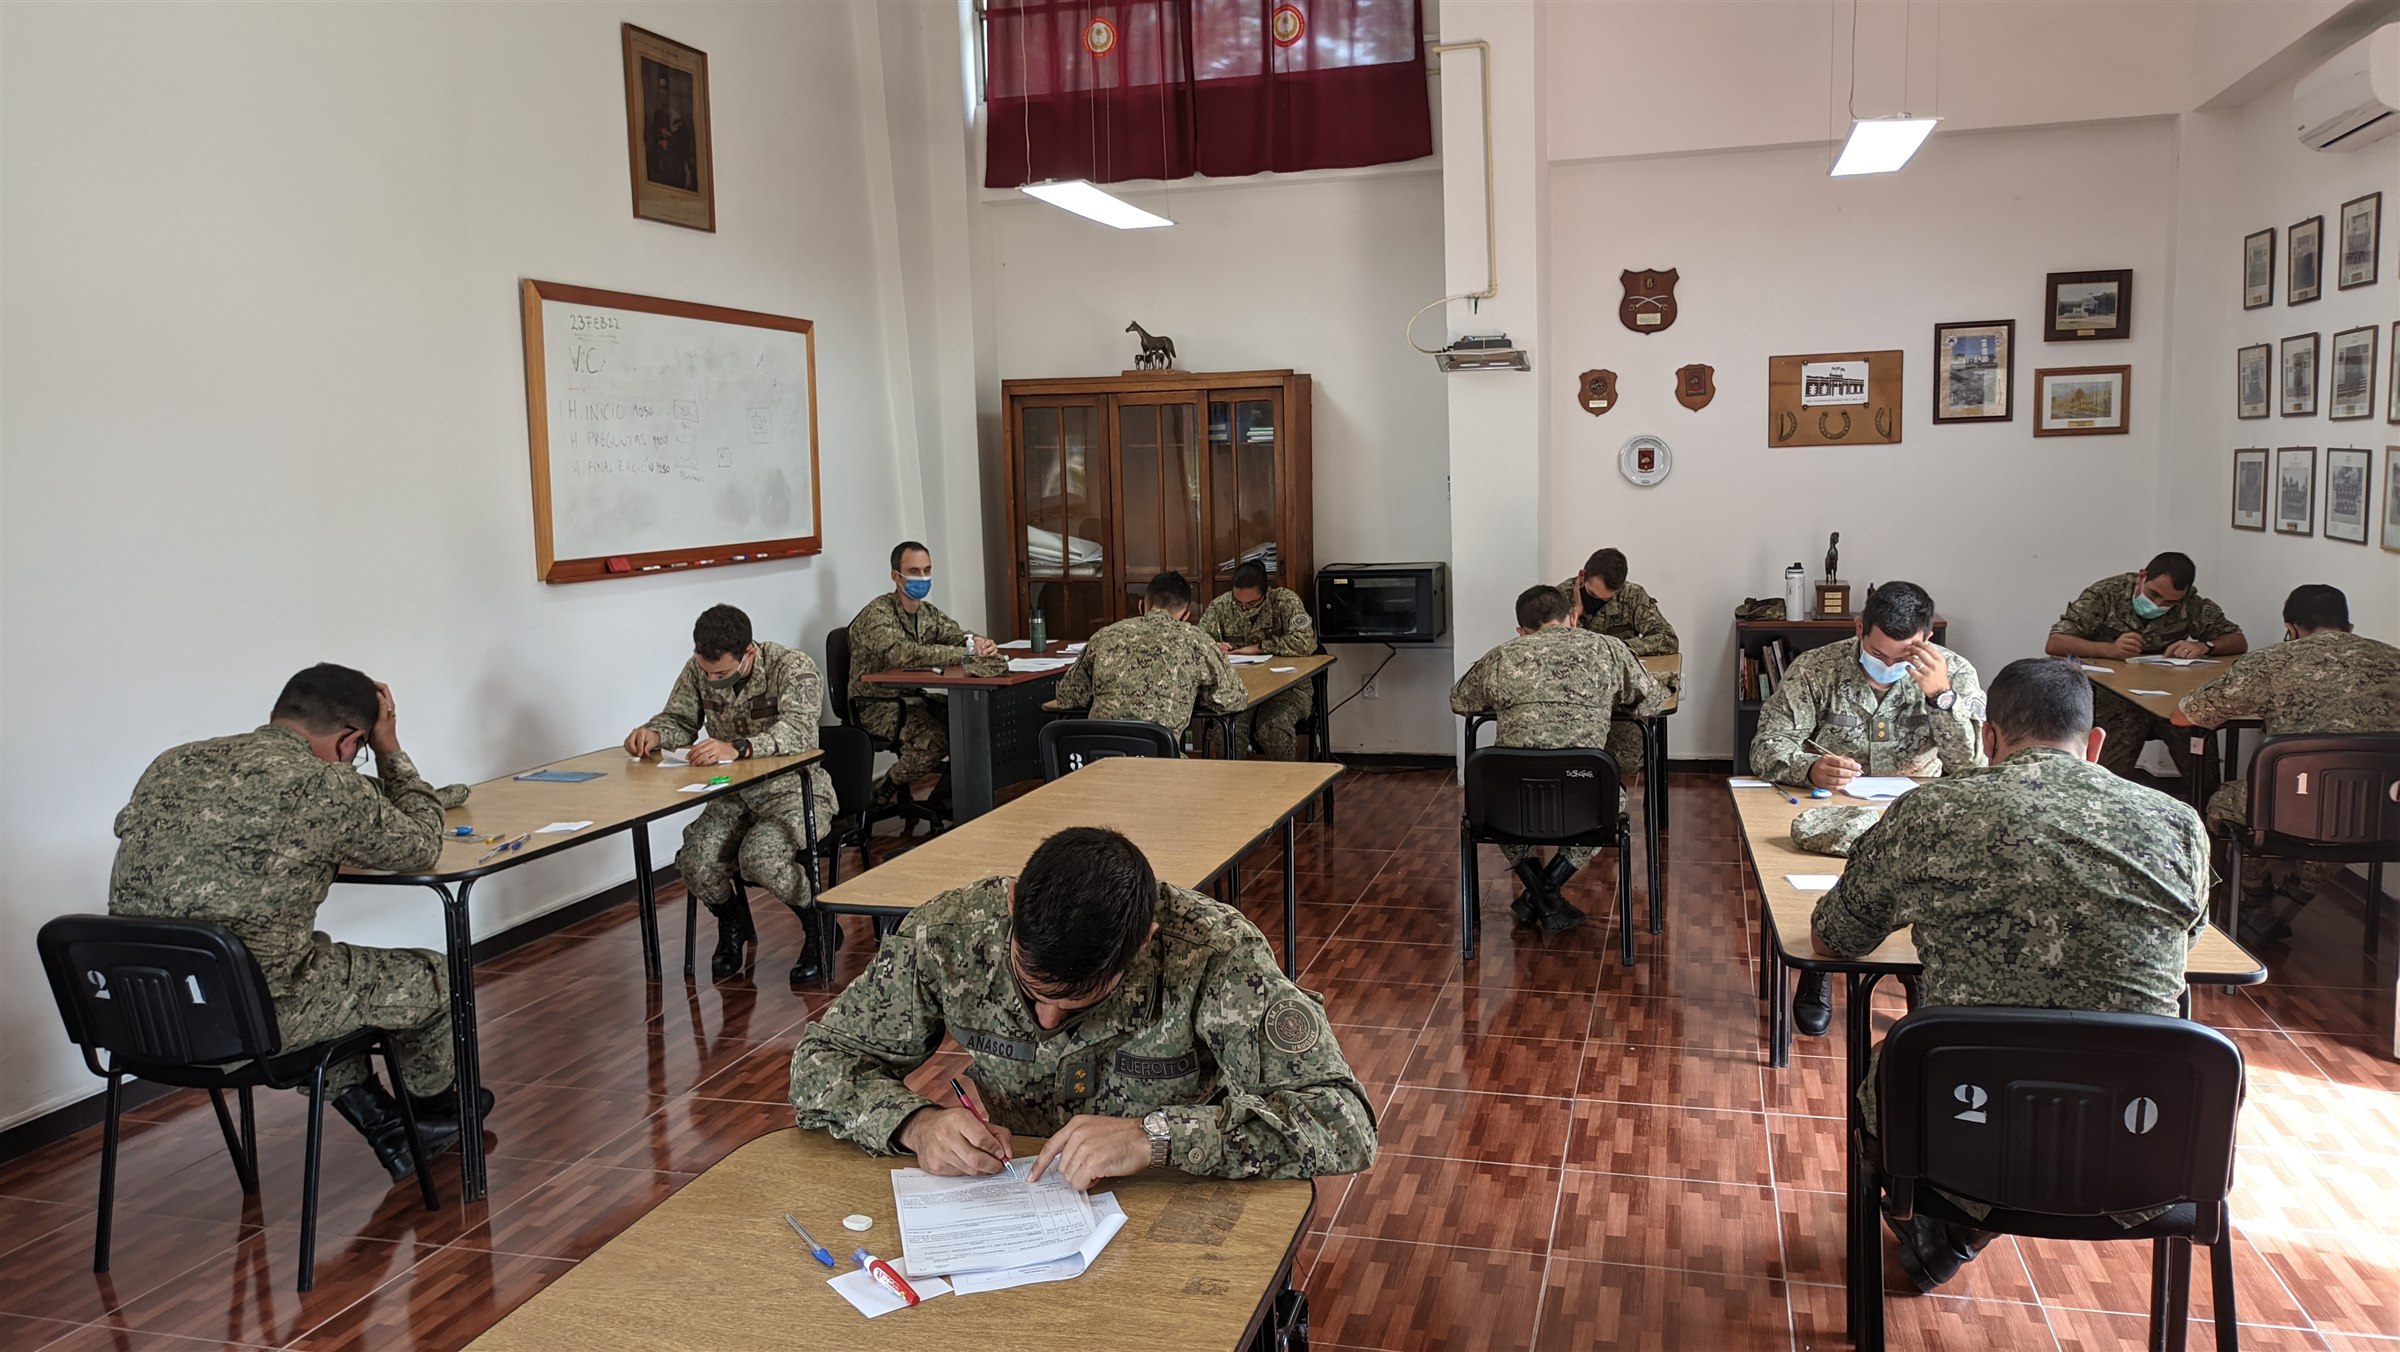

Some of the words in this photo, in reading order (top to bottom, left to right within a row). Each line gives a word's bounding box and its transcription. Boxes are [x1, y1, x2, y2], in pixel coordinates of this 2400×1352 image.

[570, 314, 620, 331] 23FEB22
[1069, 753, 1084, 771] 3
[2296, 772, 2309, 795] 1
[86, 969, 111, 1000] 2
[184, 974, 207, 1004] 1
[1120, 1057, 1189, 1076] EJERCITO
[1953, 1083, 1989, 1125] 2
[2123, 1096, 2159, 1136] 0
